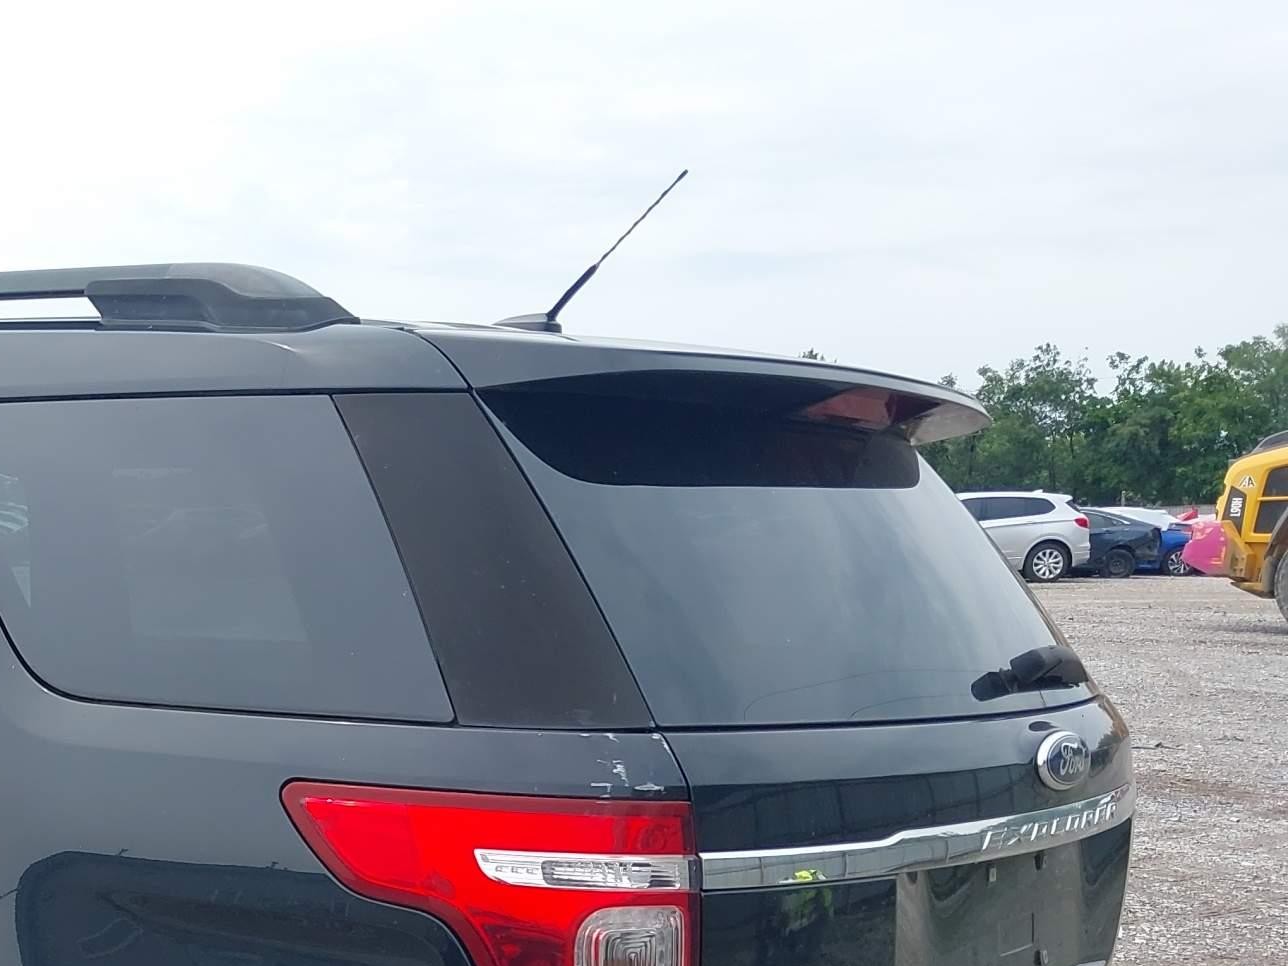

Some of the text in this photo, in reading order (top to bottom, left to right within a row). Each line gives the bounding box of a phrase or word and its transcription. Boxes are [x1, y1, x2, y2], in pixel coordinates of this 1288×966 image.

[1229, 497, 1244, 517] L90H
[1059, 742, 1090, 777] Ford
[981, 801, 1118, 851] EXPLORER
